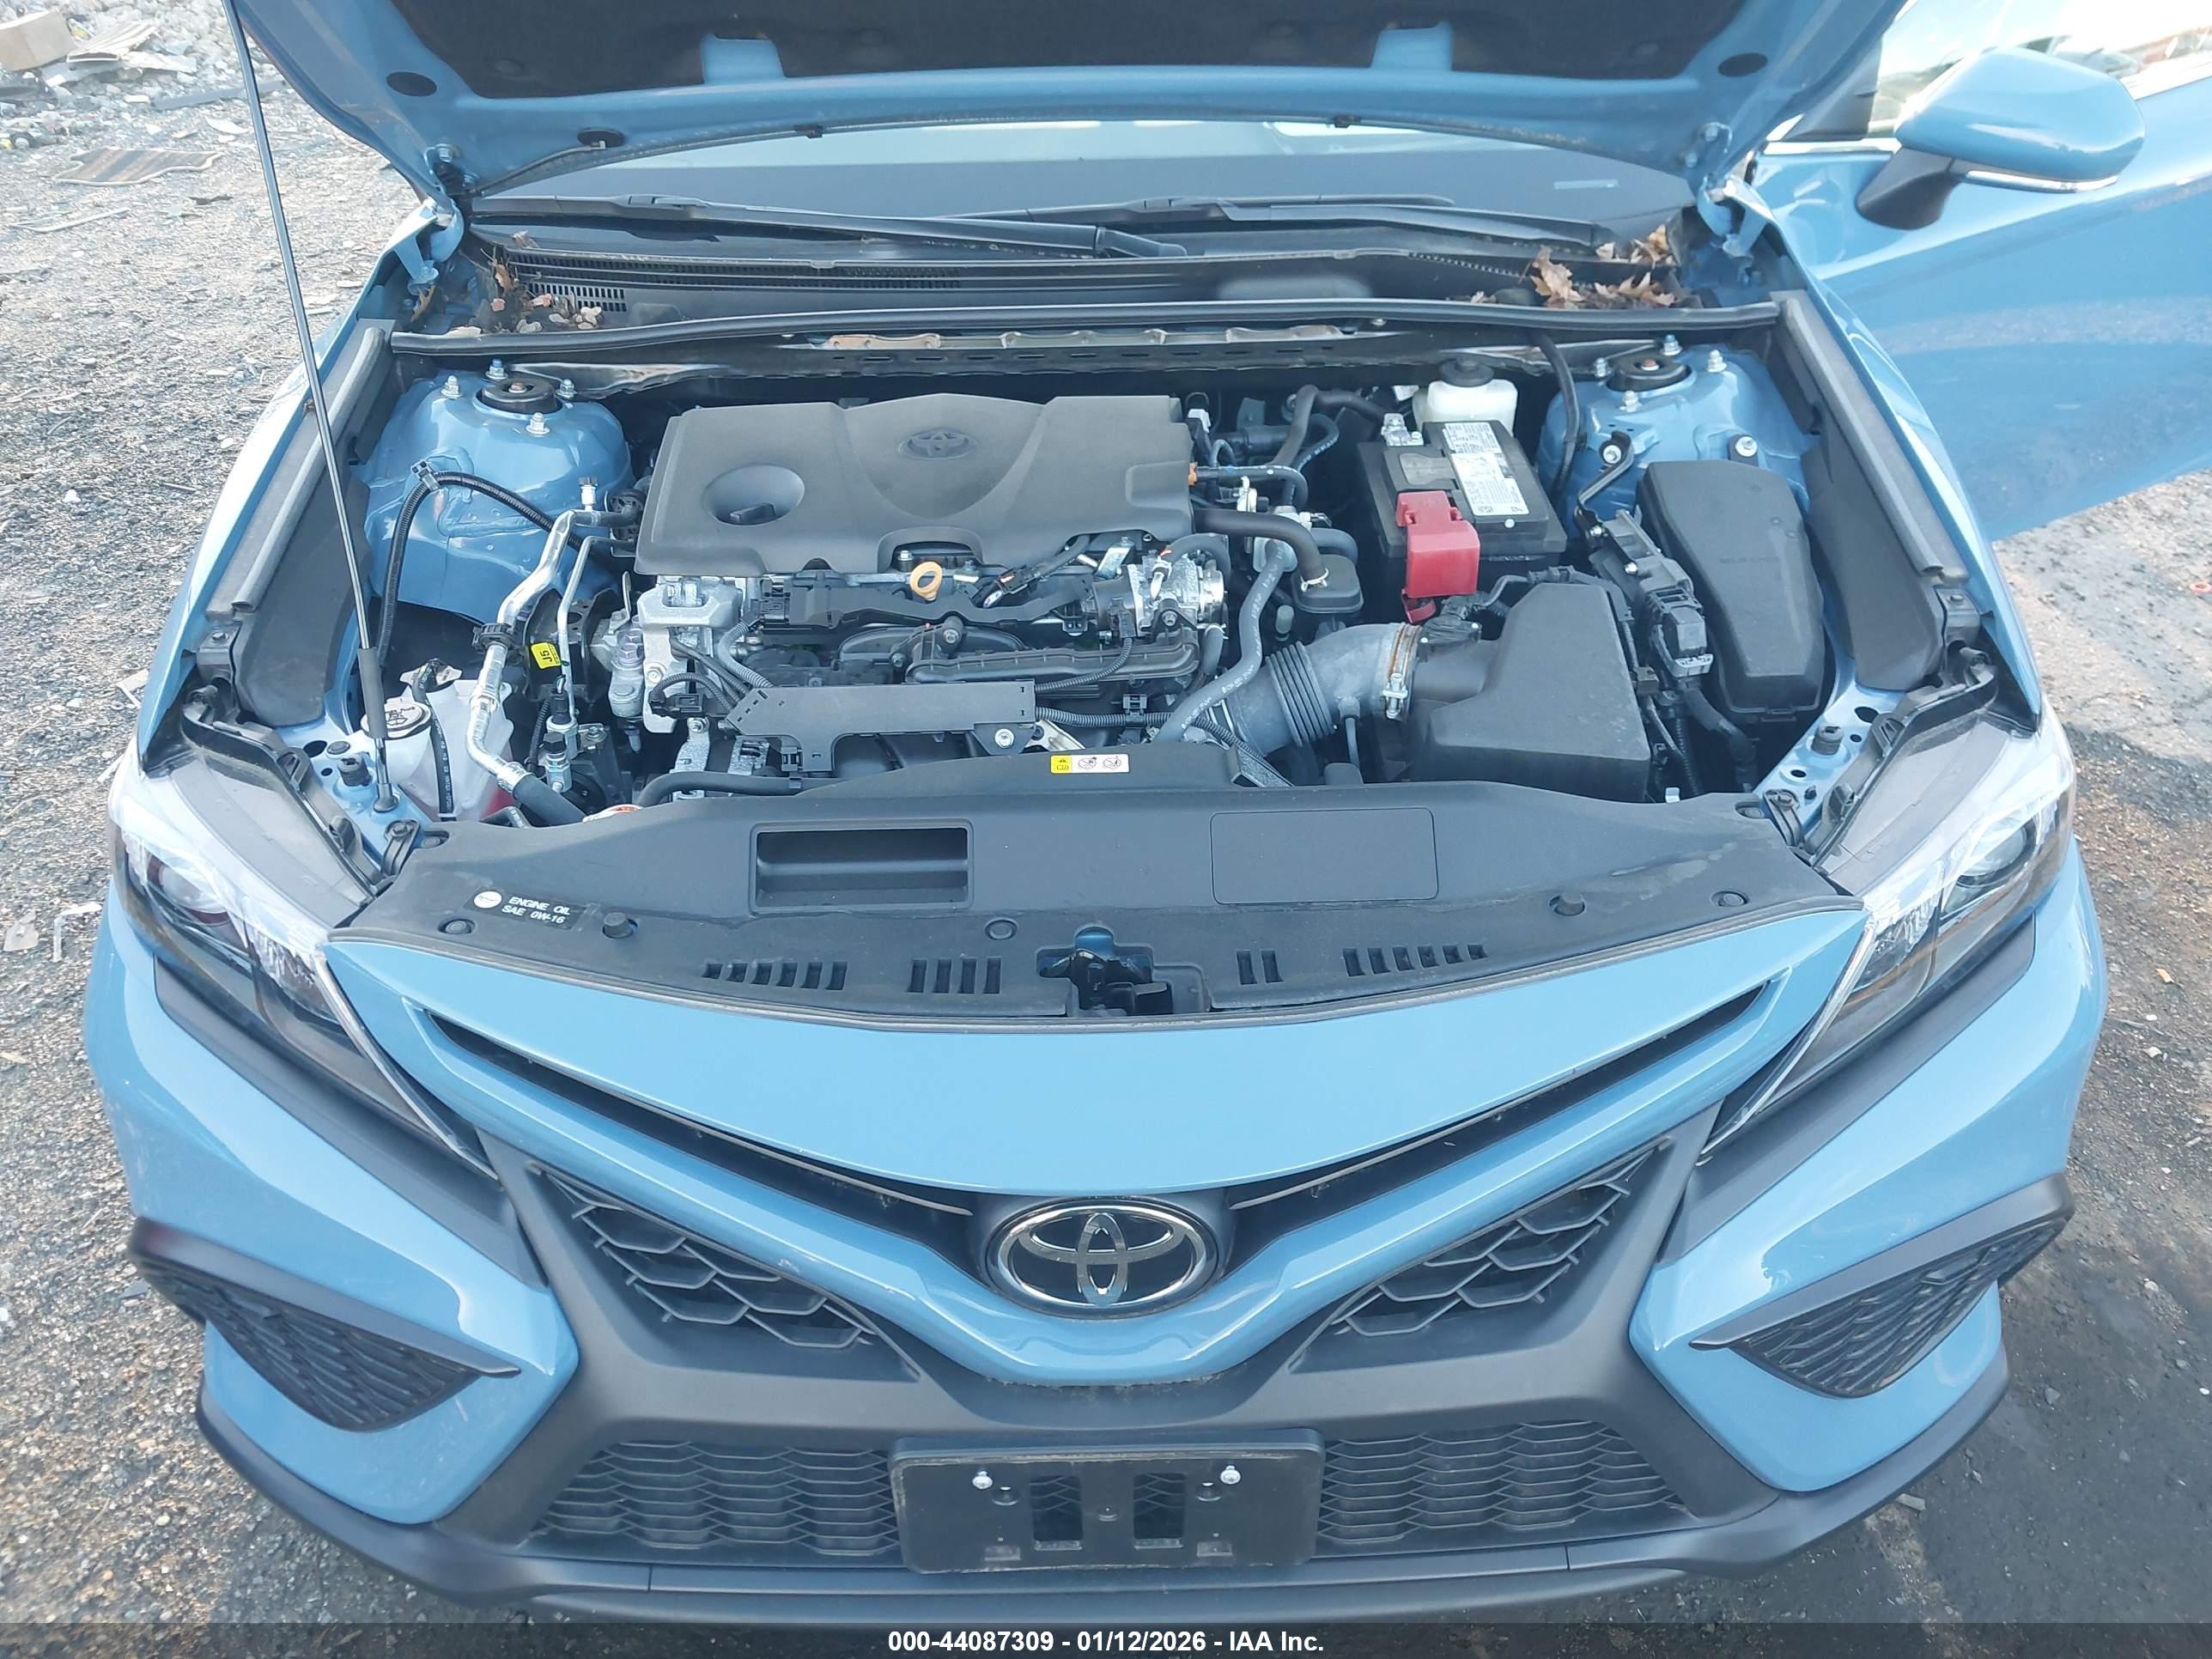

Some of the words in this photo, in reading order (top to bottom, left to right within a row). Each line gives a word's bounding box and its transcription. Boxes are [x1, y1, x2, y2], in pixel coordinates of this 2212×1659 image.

[539, 650, 553, 663] J5
[501, 905, 526, 915] SAE
[530, 910, 566, 924] 0W-16
[508, 896, 550, 910] ENGINE
[553, 905, 571, 915] OIL
